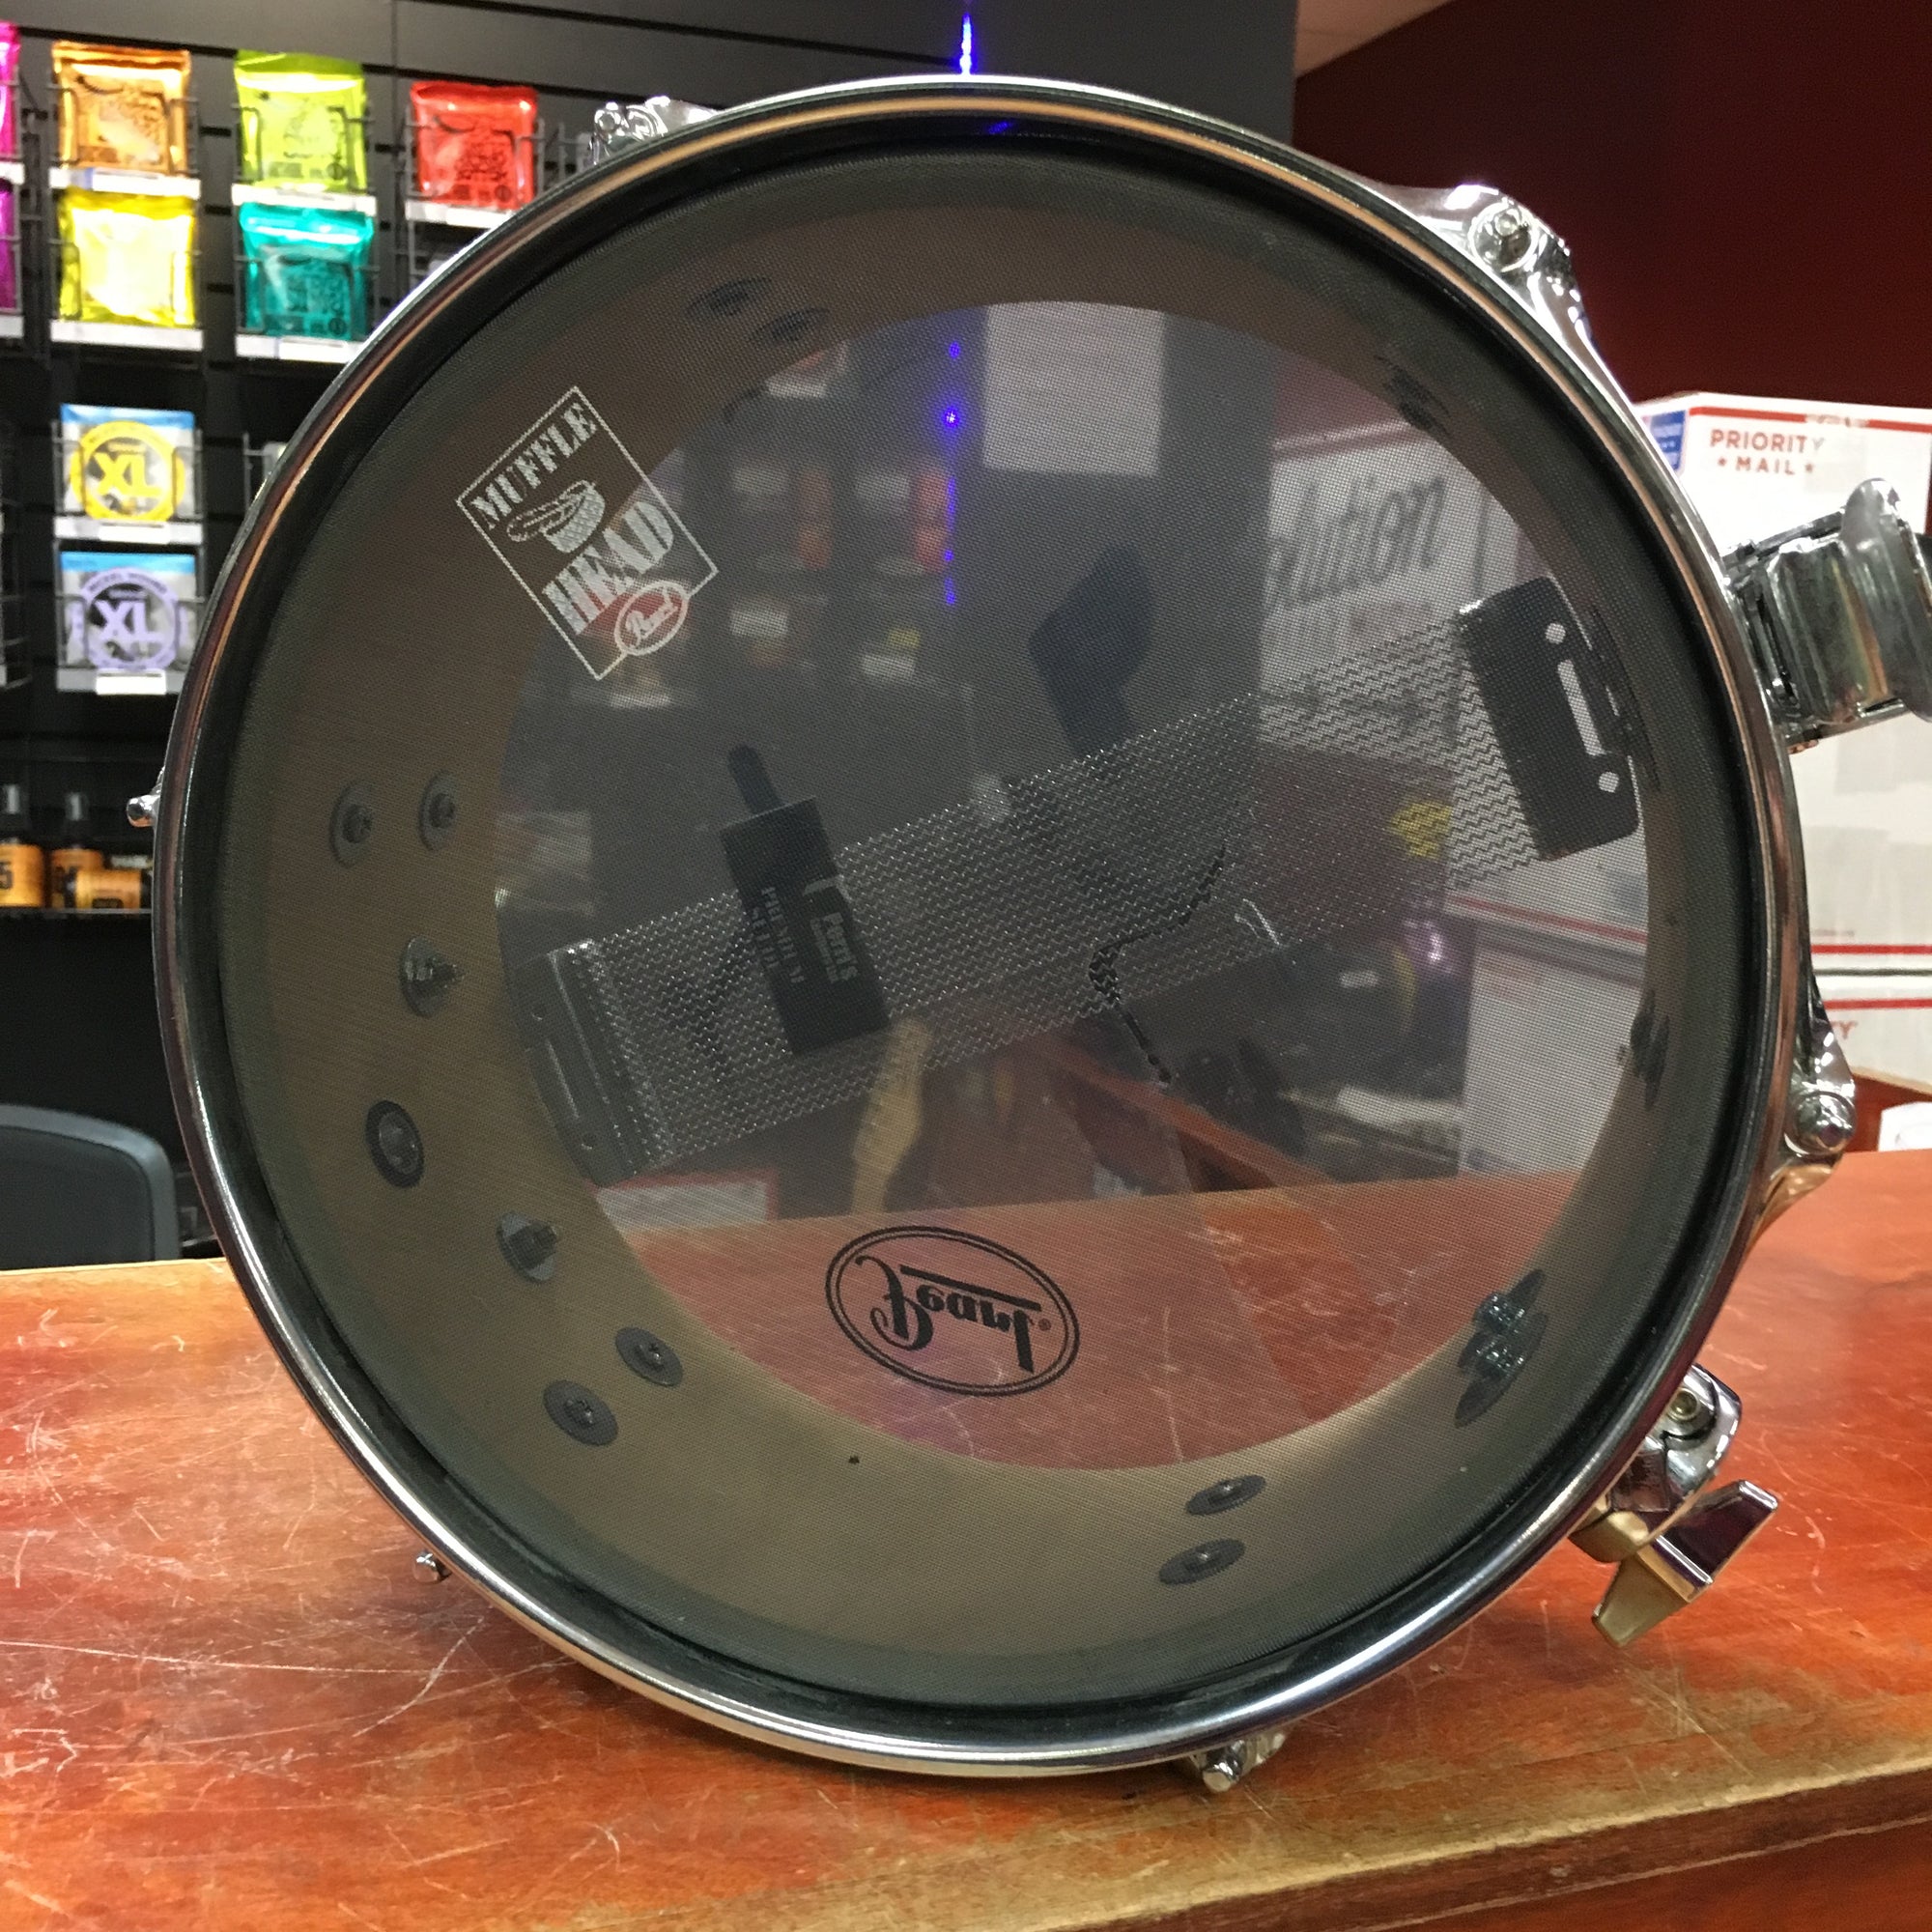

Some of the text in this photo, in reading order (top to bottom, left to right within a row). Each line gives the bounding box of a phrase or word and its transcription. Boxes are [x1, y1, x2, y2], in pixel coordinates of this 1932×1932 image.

[1710, 428, 1825, 454] PRIORITY
[94, 451, 161, 497] XL
[470, 402, 597, 530] MUFFLE
[1735, 456, 1795, 475] MAIL
[542, 500, 674, 636] HEAD
[95, 599, 163, 643] XL
